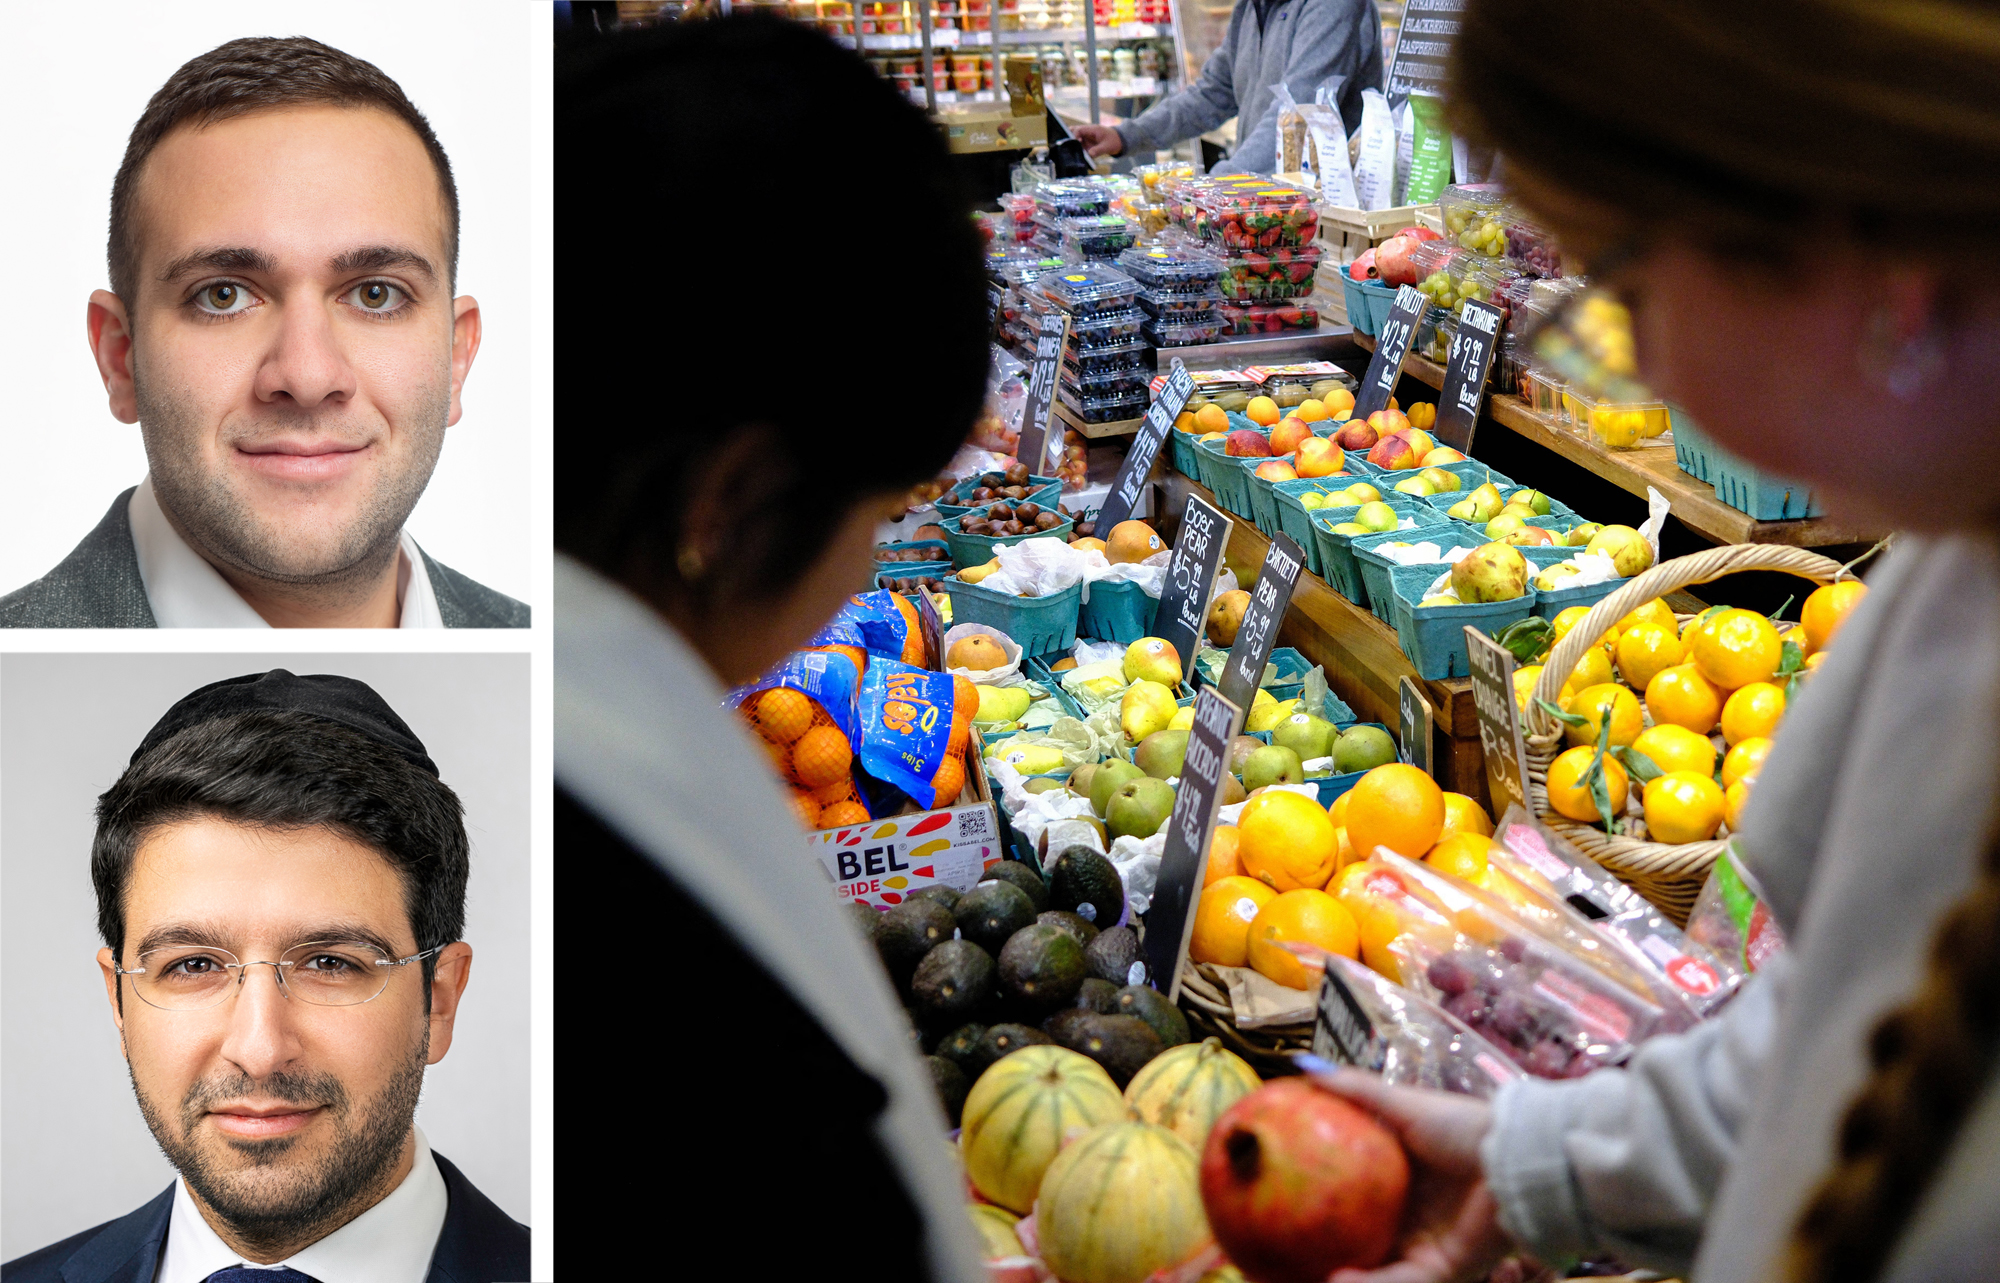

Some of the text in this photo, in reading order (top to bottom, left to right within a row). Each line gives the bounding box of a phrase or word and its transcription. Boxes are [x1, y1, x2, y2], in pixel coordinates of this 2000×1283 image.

[1460, 302, 1500, 336] NECTARINE
[1460, 382, 1478, 407] Pound
[1185, 498, 1214, 538] BOSC
[1182, 524, 1208, 560] PEAR
[1189, 586, 1198, 605] LB
[1257, 576, 1278, 612] PEAR
[1182, 599, 1200, 627] Pound
[883, 672, 934, 735] halos
[1196, 689, 1233, 746] ORGANIC
[1184, 730, 1220, 786] AVOCADO
